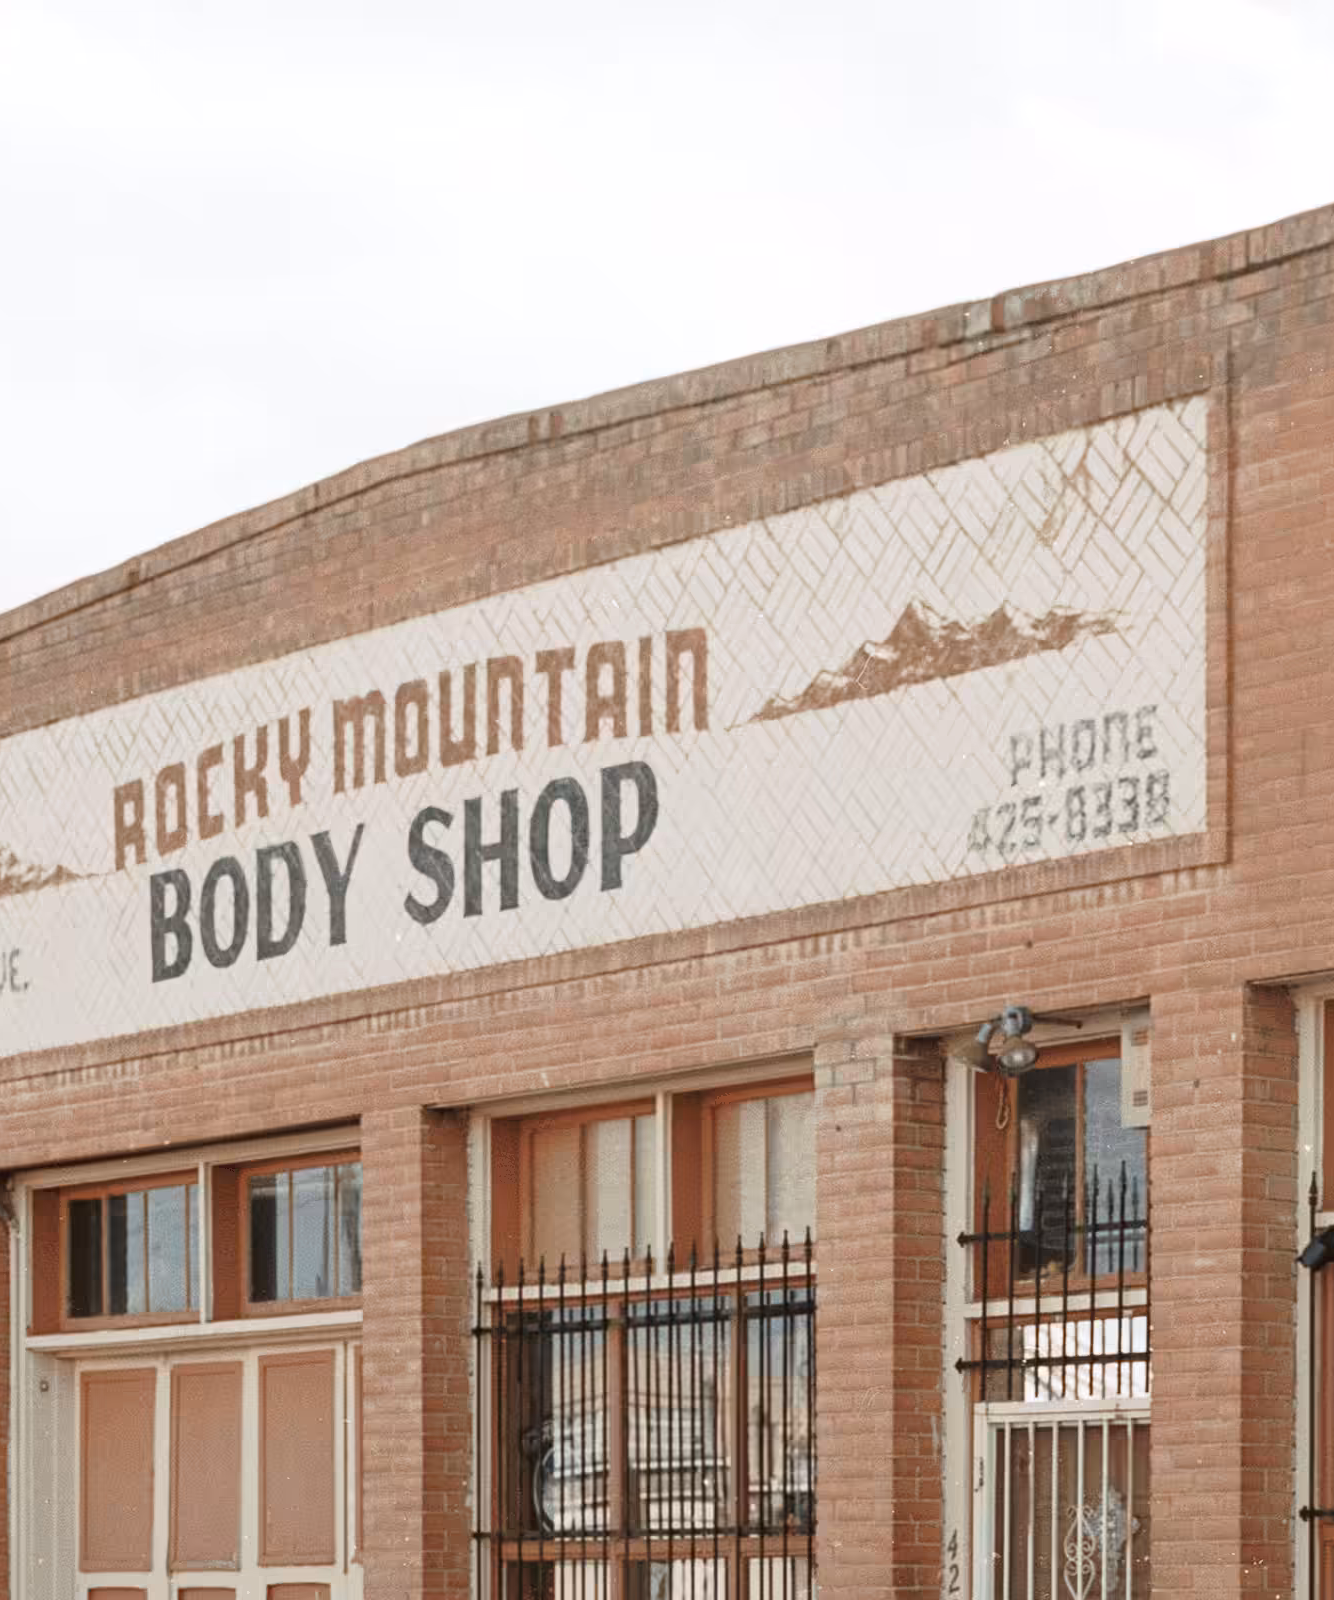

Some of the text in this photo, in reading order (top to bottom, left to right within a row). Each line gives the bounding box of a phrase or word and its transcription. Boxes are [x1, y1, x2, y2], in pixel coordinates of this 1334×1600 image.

[113, 627, 709, 870] ROCKY MOUNTAIN
[1010, 704, 1158, 787] PHONE
[150, 760, 660, 983] BODY SHOP
